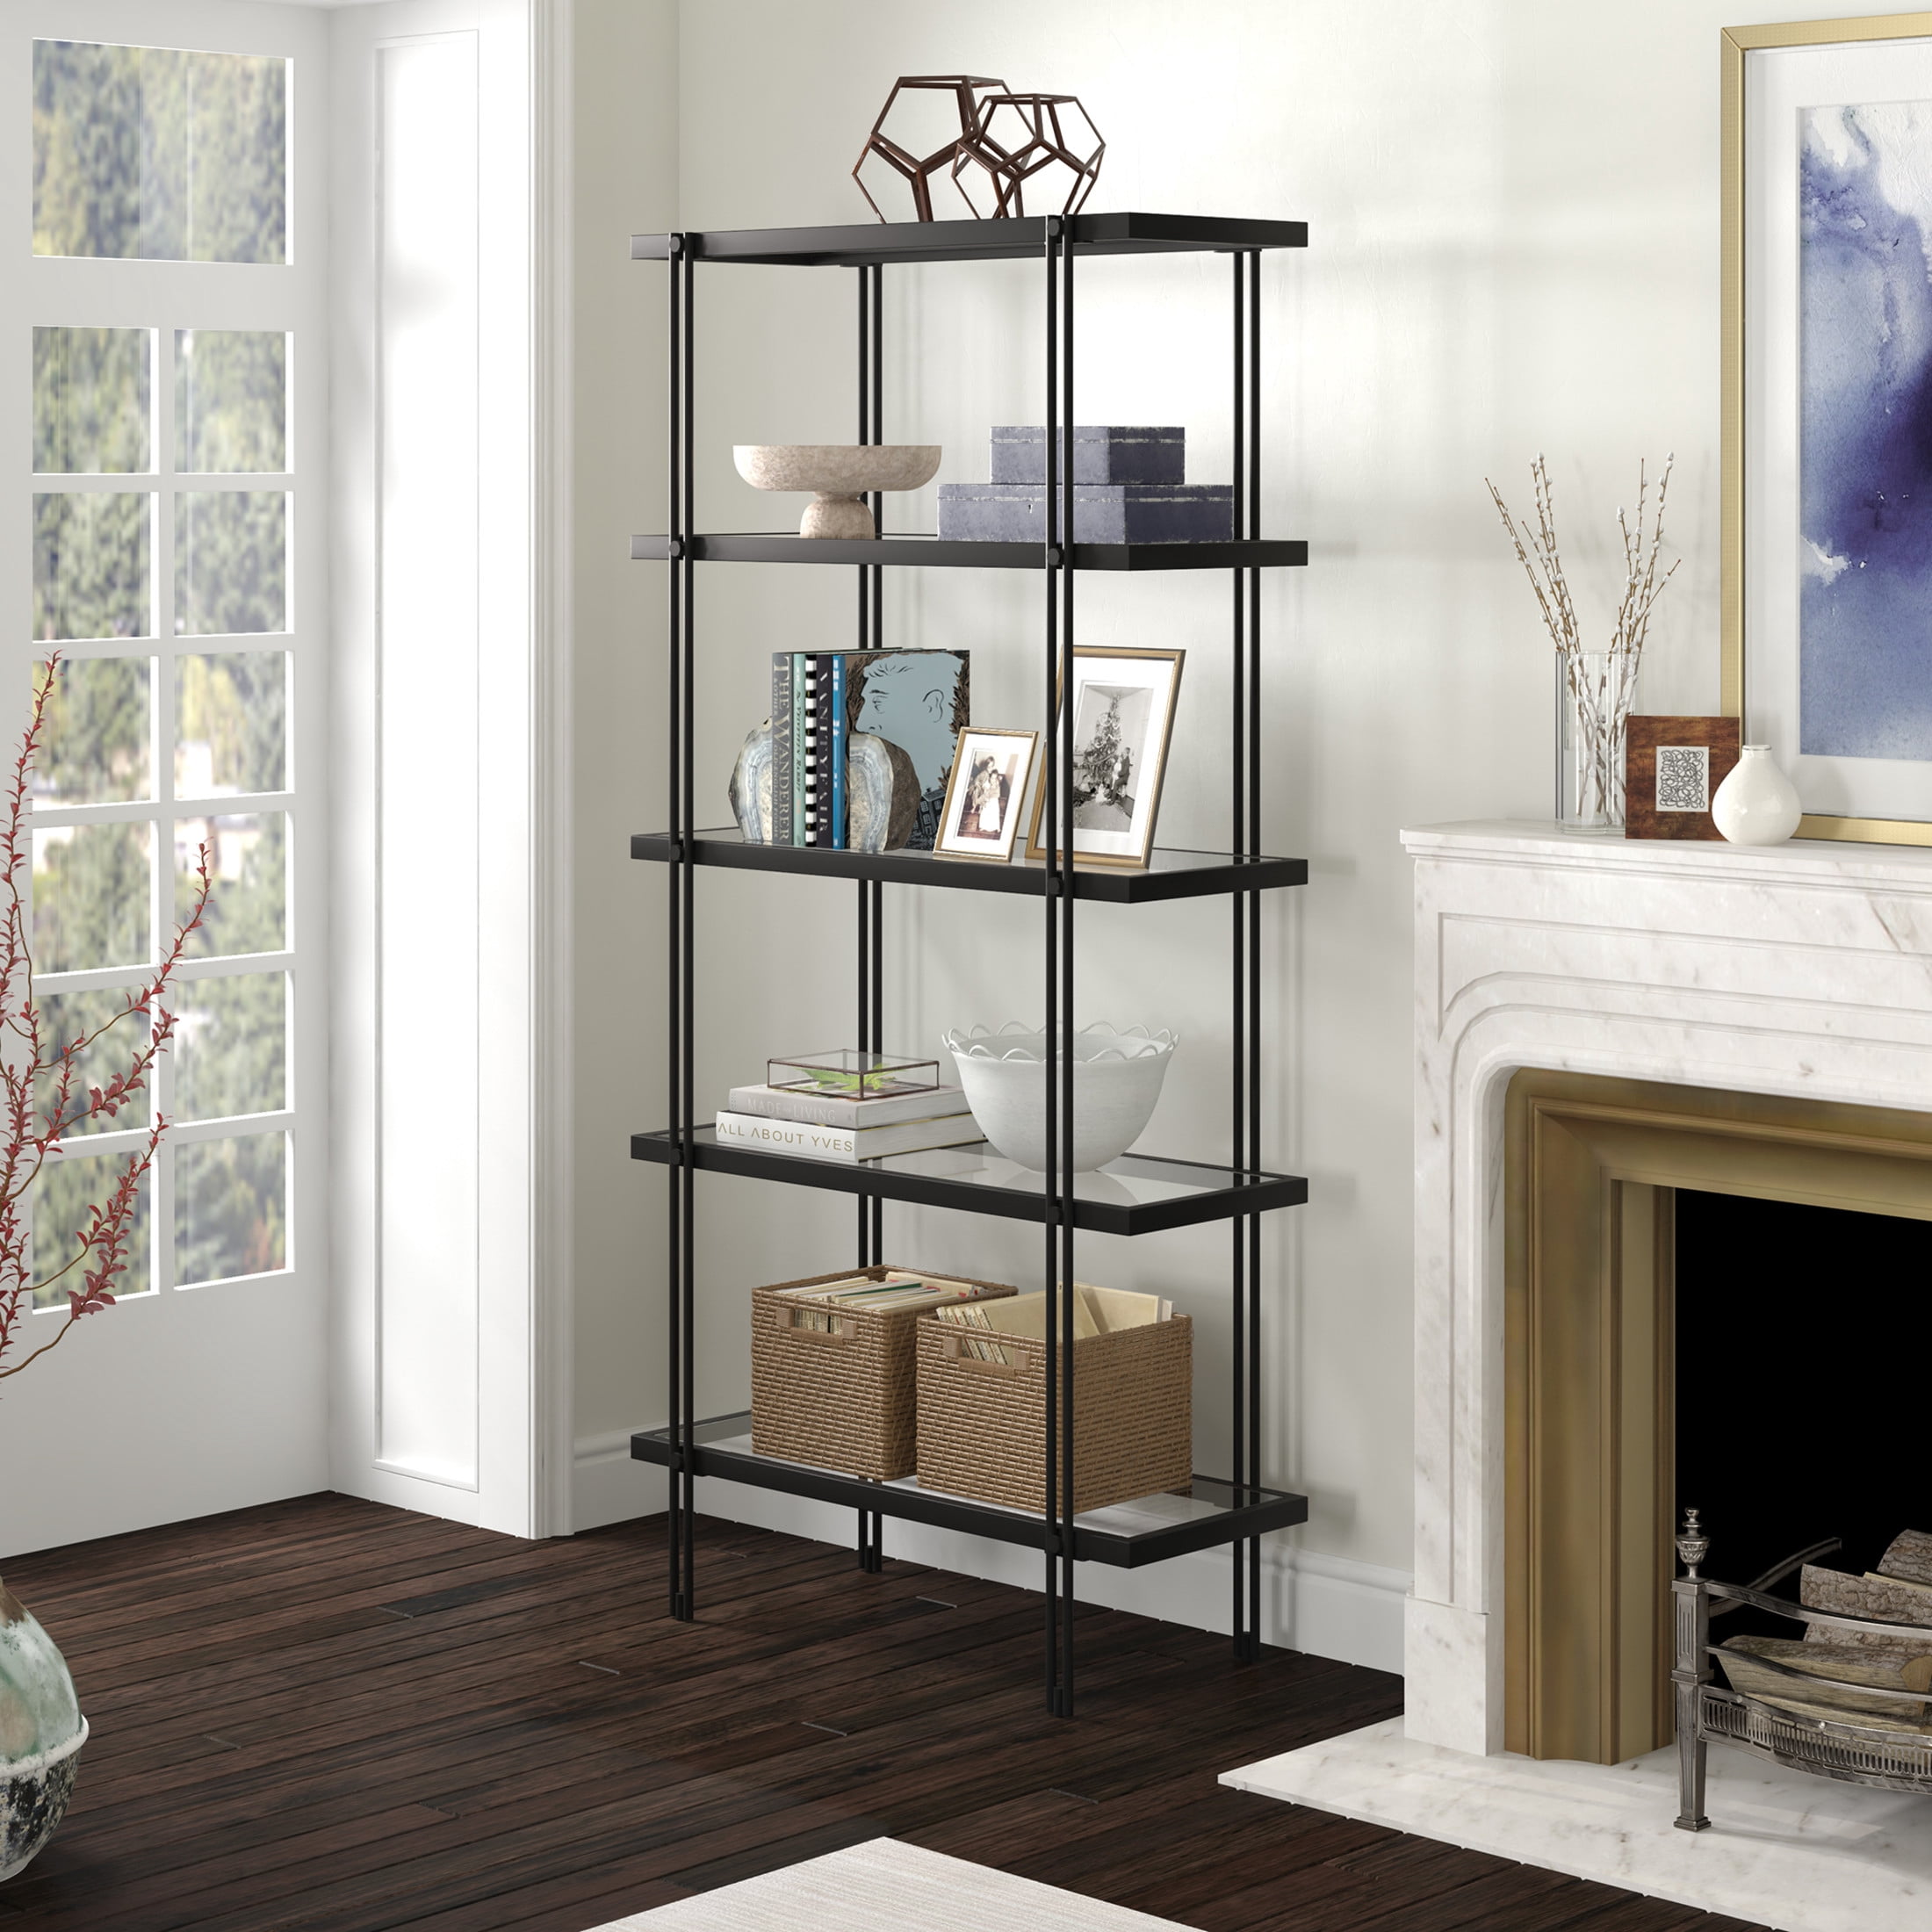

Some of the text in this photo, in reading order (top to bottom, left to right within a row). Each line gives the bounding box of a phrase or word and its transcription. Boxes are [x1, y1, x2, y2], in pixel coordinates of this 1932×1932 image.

[773, 656, 790, 840] THE WANDERER
[747, 1097, 835, 1122] MADE LIVING
[717, 1122, 853, 1152] ALL ABOUT YVES
